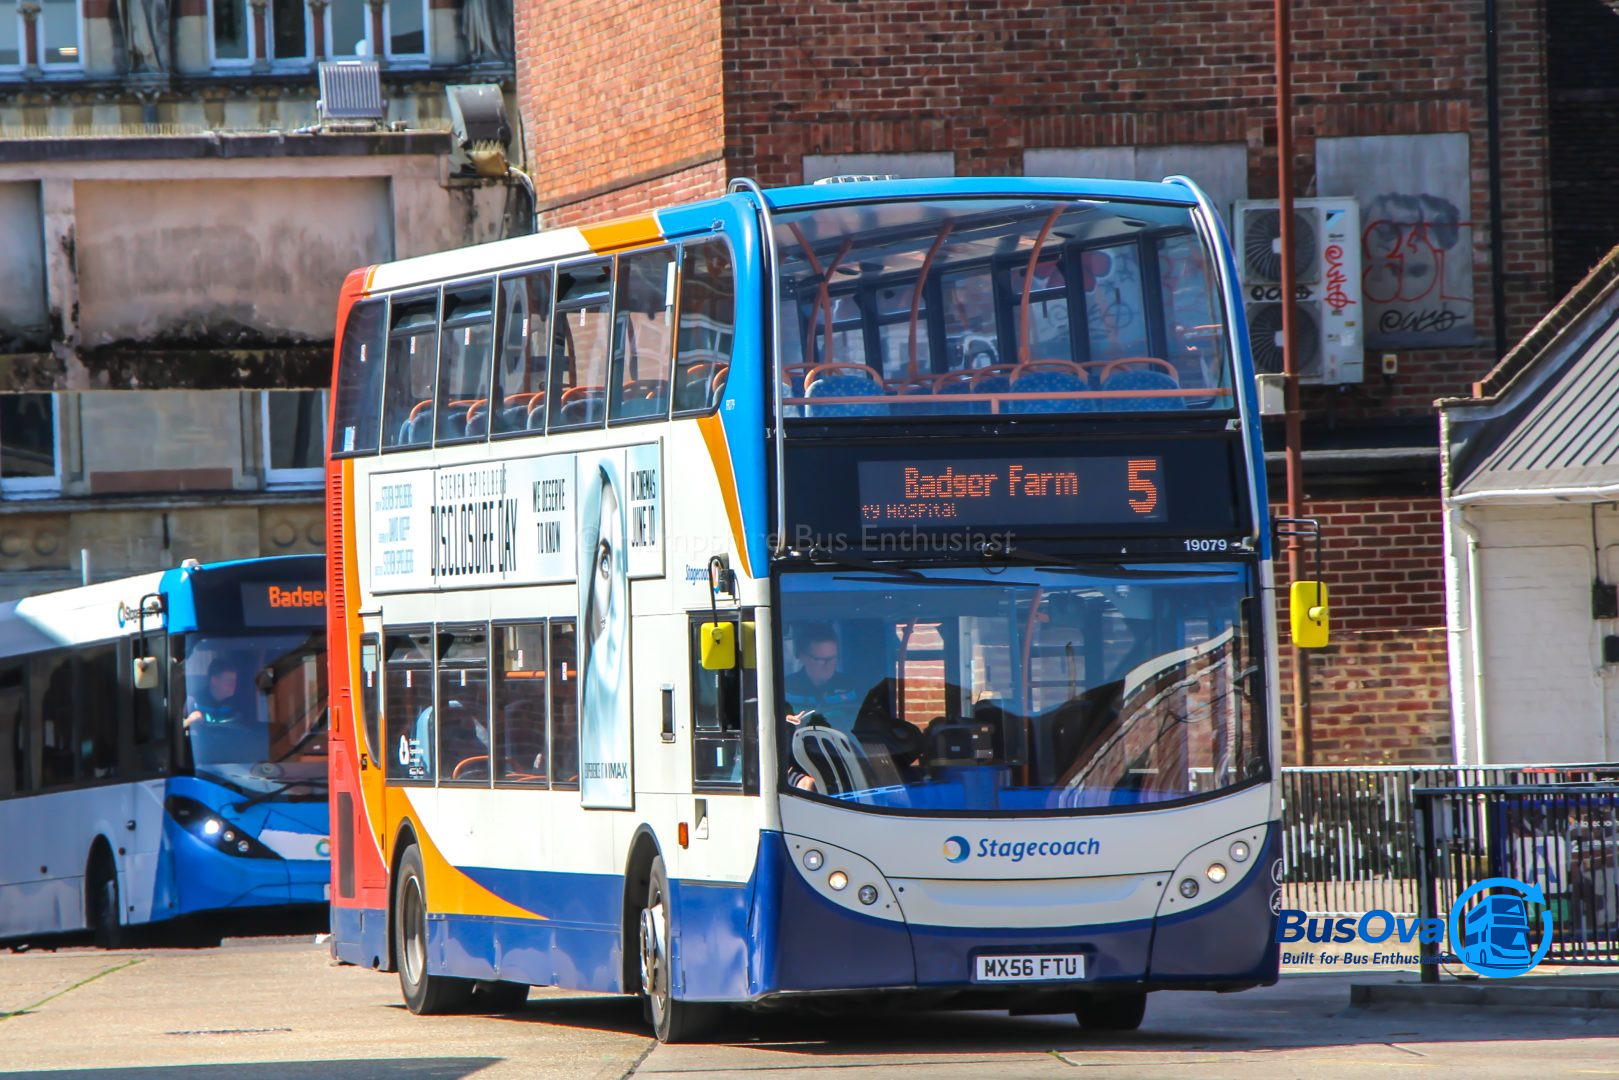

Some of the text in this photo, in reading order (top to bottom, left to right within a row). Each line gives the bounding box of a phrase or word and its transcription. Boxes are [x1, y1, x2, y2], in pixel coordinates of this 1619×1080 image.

[542, 478, 565, 512] DESERVE
[904, 464, 1078, 499] Badger Farm
[1127, 459, 1157, 514] 5
[430, 498, 517, 577] DISCLOSURE DAY
[1183, 539, 1227, 552] 19079
[977, 837, 1100, 862] Stagecoach
[984, 958, 1077, 977] MX56 FTU
